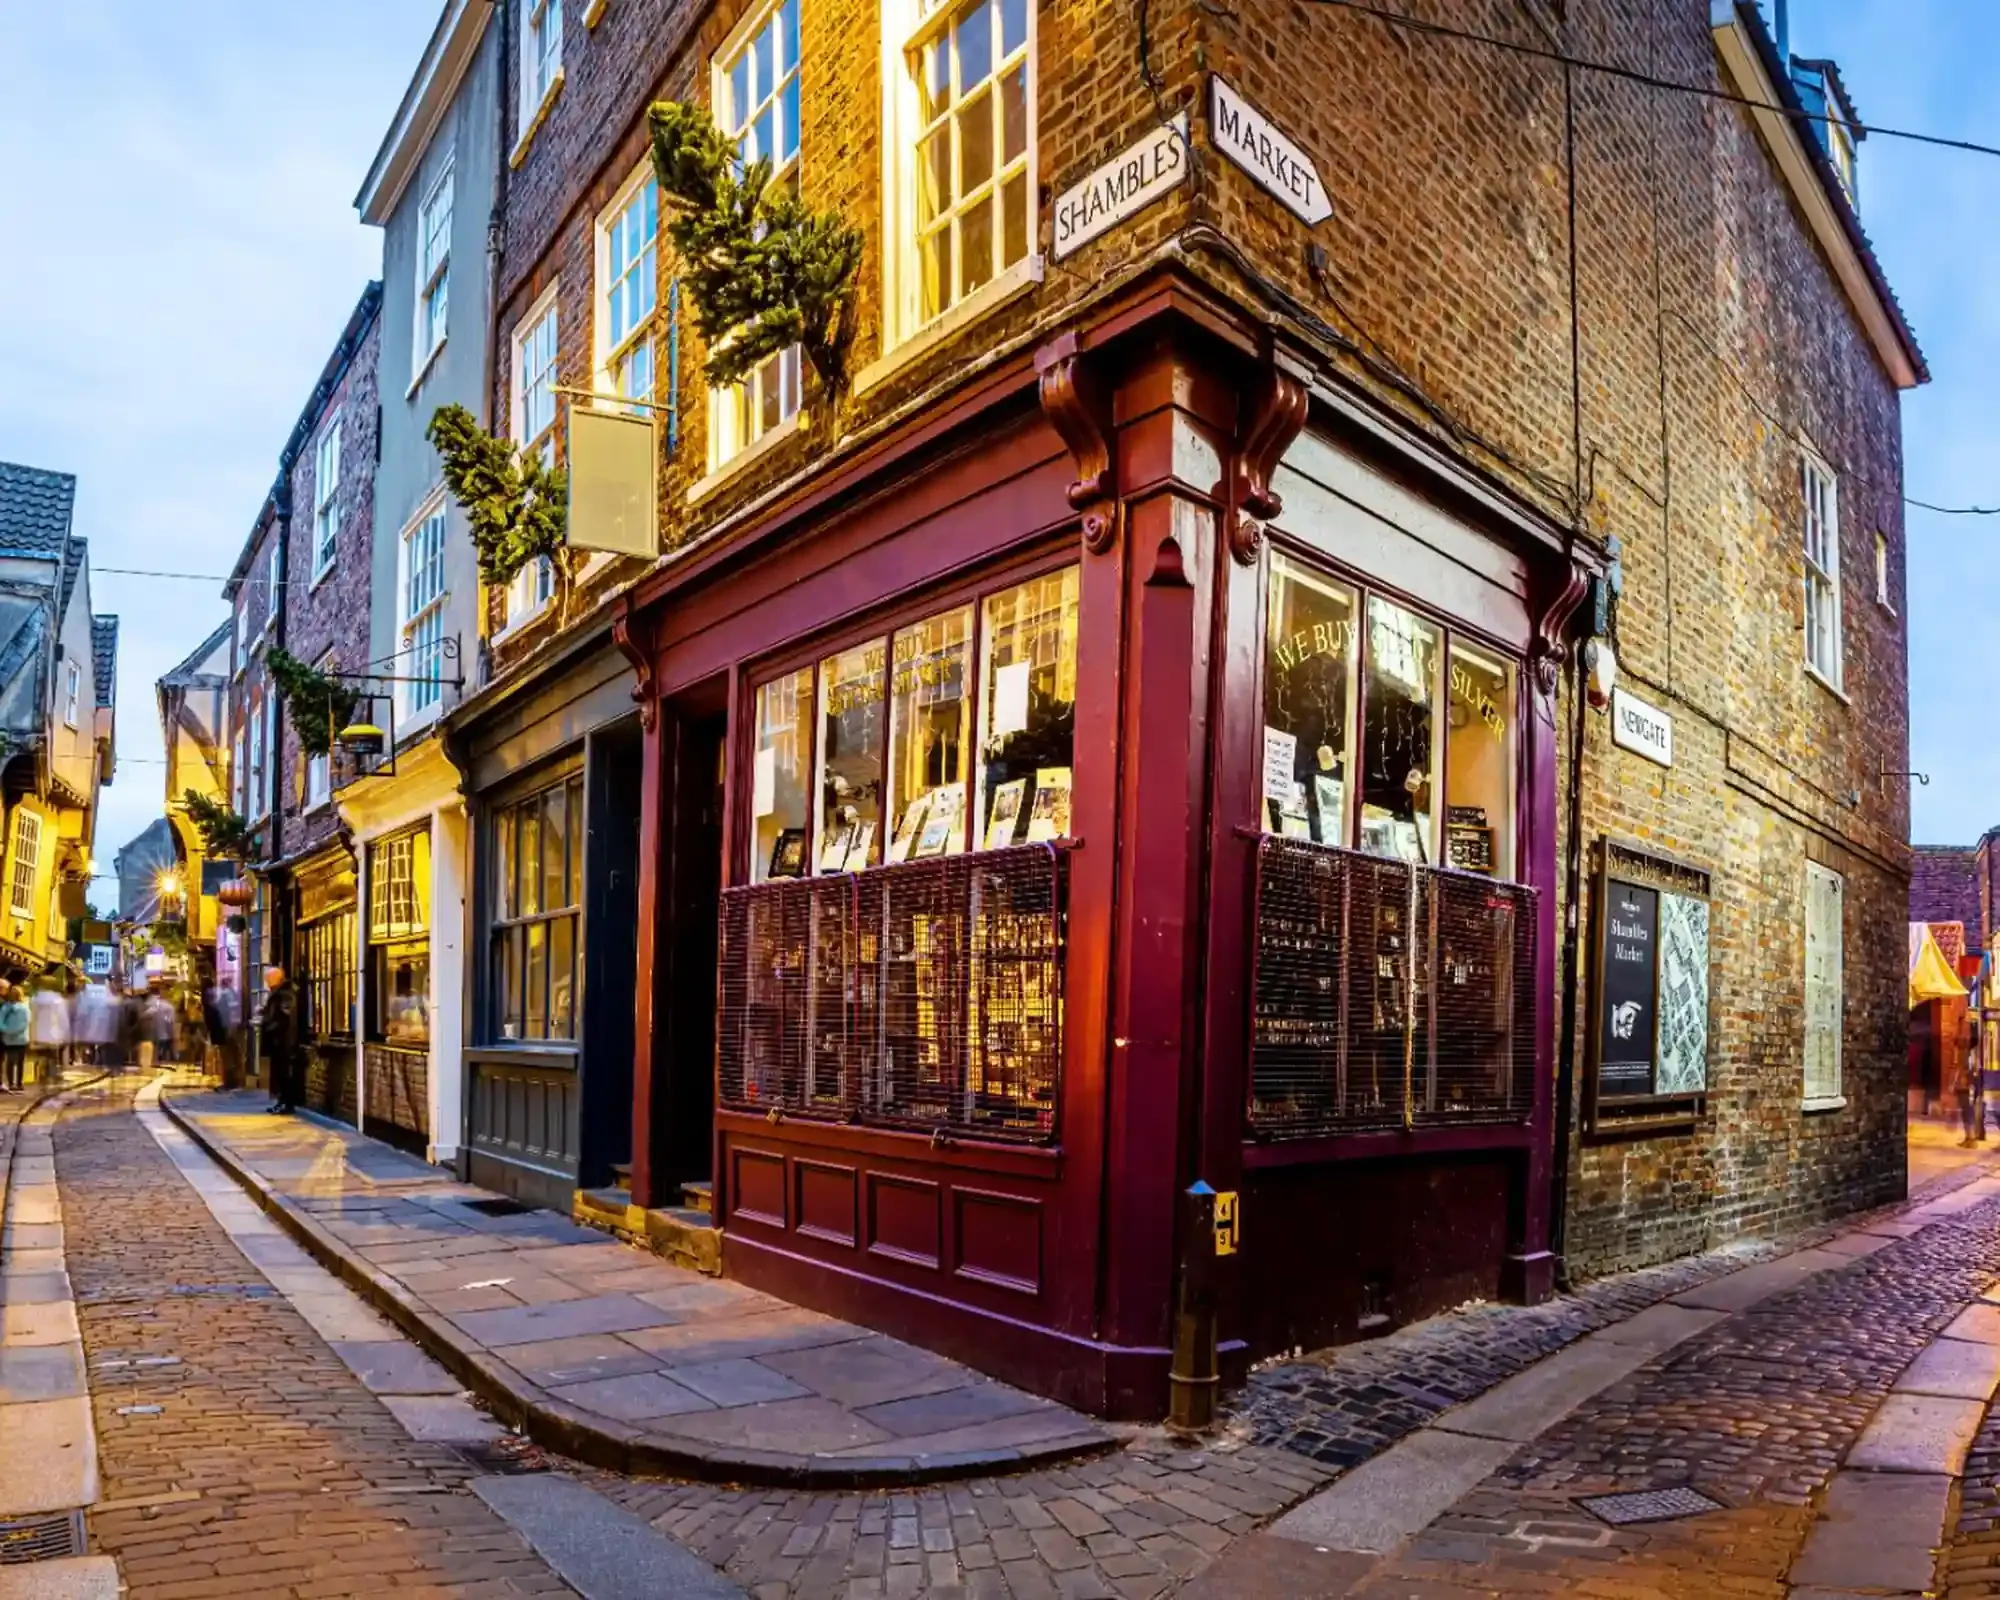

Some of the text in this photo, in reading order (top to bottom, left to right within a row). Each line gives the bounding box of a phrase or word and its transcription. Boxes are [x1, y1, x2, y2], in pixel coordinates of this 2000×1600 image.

[1058, 131, 1182, 241] SHAMBLES
[1218, 96, 1316, 206] MARKET
[1275, 630, 1311, 671] WE
[1312, 619, 1357, 653] BUY
[1450, 663, 1506, 745] SILVER
[1620, 704, 1667, 749] NEWGATE
